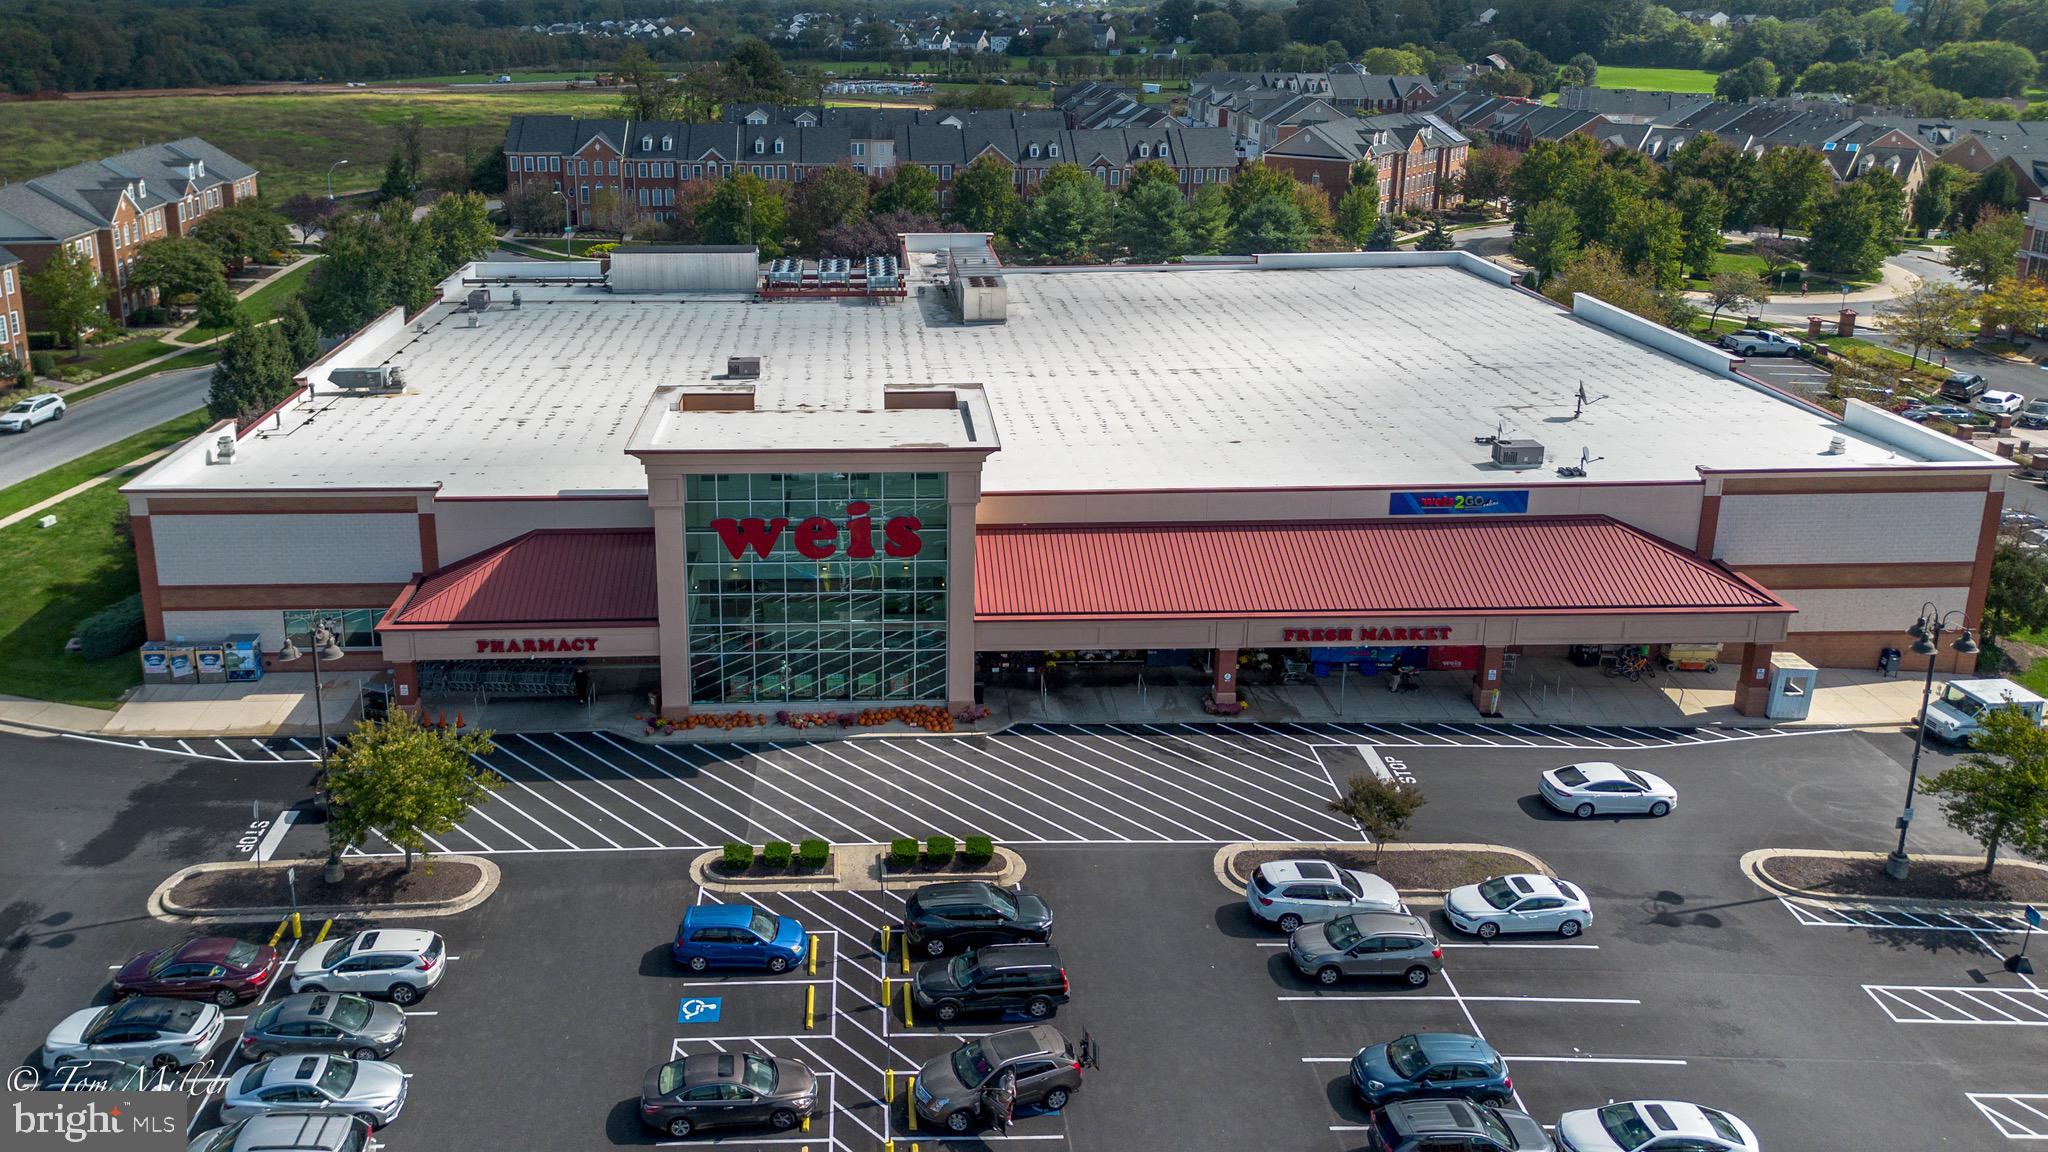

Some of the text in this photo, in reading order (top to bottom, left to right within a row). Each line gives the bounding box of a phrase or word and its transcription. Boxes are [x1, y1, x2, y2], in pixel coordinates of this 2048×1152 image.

[710, 501, 922, 560] weis
[476, 638, 599, 653] PHARMACY
[1283, 626, 1452, 642] FRESH MARKET
[1385, 756, 1417, 784] STOP
[236, 820, 270, 852] STOP
